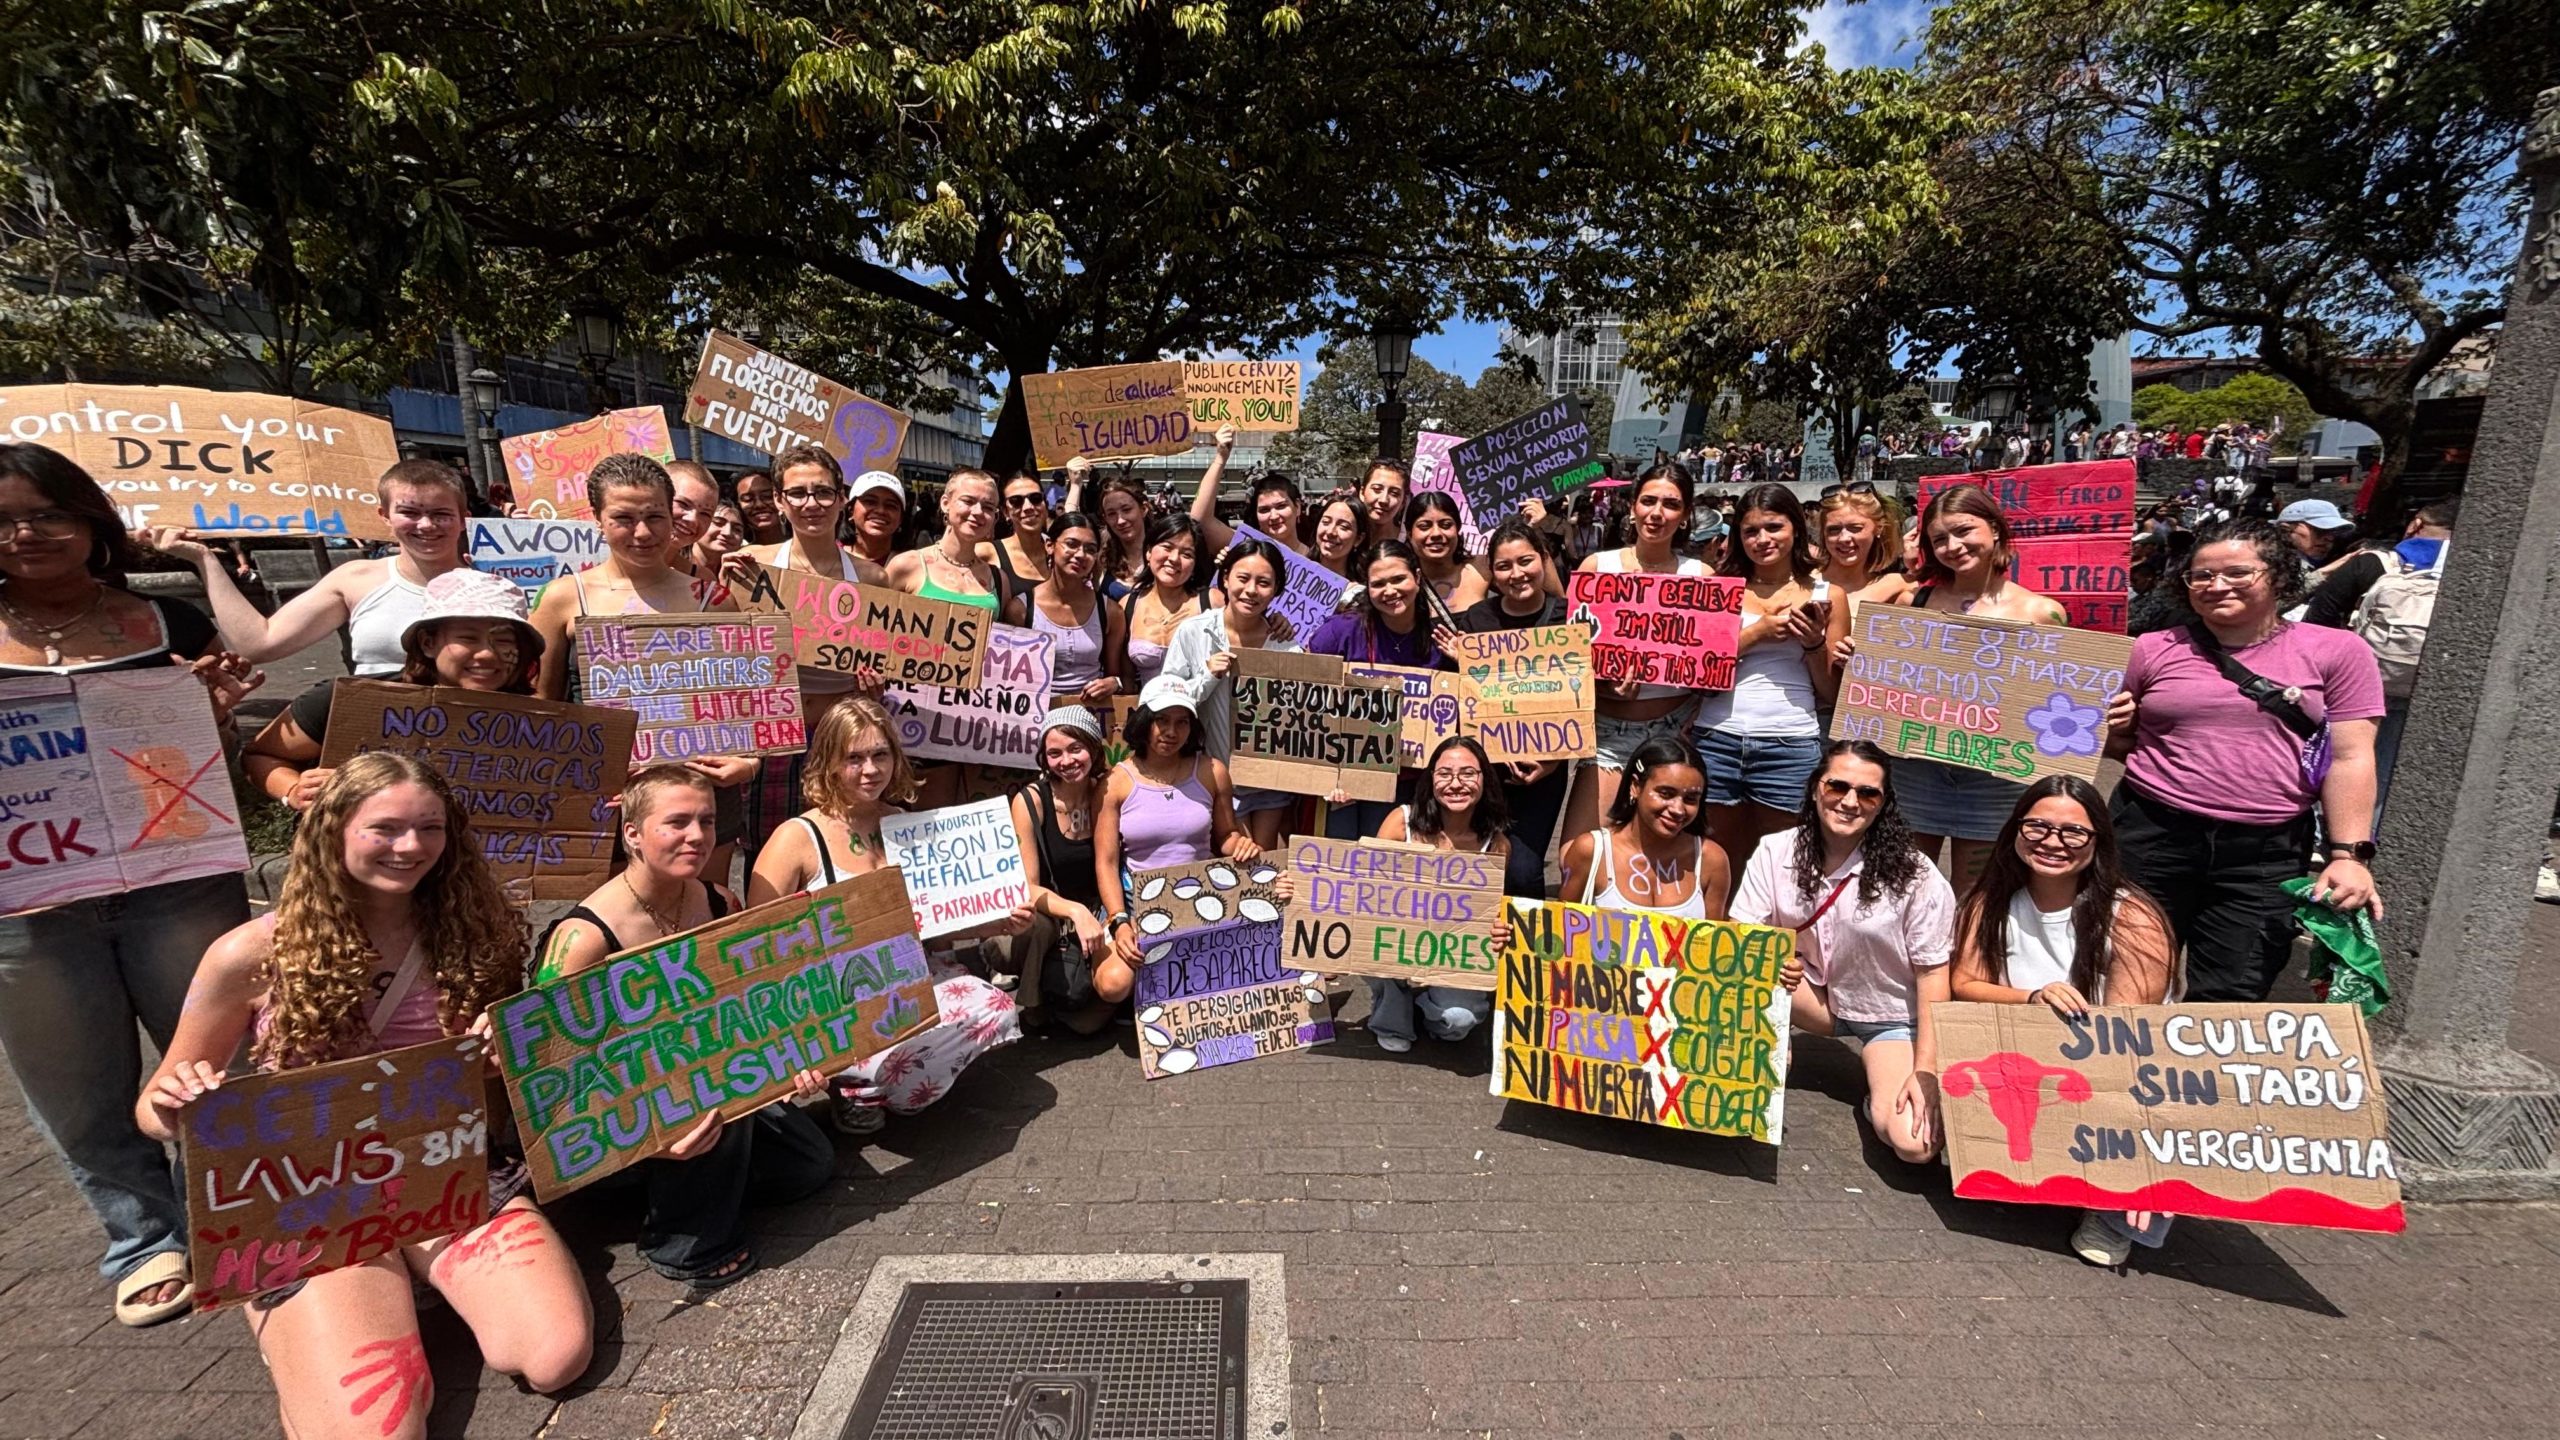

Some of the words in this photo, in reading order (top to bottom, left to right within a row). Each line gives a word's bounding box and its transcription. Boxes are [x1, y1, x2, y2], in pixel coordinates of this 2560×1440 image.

[709, 353, 829, 422] FLORECEMOS
[747, 350, 819, 394] JUNTAS
[1183, 362, 1236, 381] PUBLIC
[1239, 362, 1297, 378] CERVIX
[1184, 378, 1286, 395] NNOUNCEMENT
[221, 412, 344, 448] your
[1074, 410, 1190, 453] IGUALDAD
[1242, 398, 1293, 424] YOU!
[109, 436, 275, 475] DICK
[1458, 443, 1483, 466] MI
[1485, 402, 1569, 454] POSICION
[1465, 446, 1525, 487] SEXUAL
[1522, 420, 1590, 460] FAVORITA
[168, 476, 218, 496] try
[227, 478, 256, 493] to
[269, 481, 380, 505] contro
[1467, 487, 1493, 509] ES
[1495, 474, 1518, 497] YO
[1522, 447, 1578, 484] ARRIBA
[1578, 441, 1588, 458] Y
[2056, 485, 2122, 506] TIRED
[193, 502, 349, 536] World
[471, 523, 505, 556] A
[2037, 564, 2127, 593] TIRED
[751, 570, 786, 610] A
[944, 616, 978, 652] IS
[583, 623, 640, 665] WE
[643, 627, 715, 657] ARE
[716, 625, 778, 653] THE
[1461, 628, 1530, 660] SEAMOS
[1533, 627, 1570, 648] LAS
[1867, 613, 1967, 655] ESTE
[1972, 627, 2002, 669] 8
[2016, 628, 2064, 655] DE
[589, 656, 772, 699] DAUGHTERS
[1497, 651, 1586, 683] LOCAS
[1851, 652, 2005, 706] QUEREMOS
[692, 687, 797, 723] WITCHES
[899, 699, 918, 717] A
[938, 683, 1032, 716] ENSEÑO
[1231, 676, 1261, 705] LA
[1503, 699, 1520, 714] EL
[1847, 682, 2002, 734] DERECHOS
[383, 706, 448, 738] NO
[458, 711, 604, 757] SOMOS
[1234, 723, 1395, 765] FEMINISTA!
[1480, 718, 1584, 756] MUNDO
[1842, 712, 1884, 744] NO
[1897, 720, 2036, 778] FLORES
[451, 785, 559, 822] OMOS
[894, 825, 917, 844] MY
[924, 808, 996, 837] FAVOURITE
[899, 829, 988, 869] SEASON
[993, 823, 1015, 851] IS
[996, 853, 1021, 874] OF
[1295, 841, 1489, 889] QUEREMOS
[1628, 852, 1683, 897] 8M
[932, 880, 1026, 925] PATRIARCHY
[1309, 876, 1473, 923] DERECHOS
[1291, 919, 1352, 961] NO
[1372, 925, 1499, 972] FLORES
[1506, 901, 1553, 956] NI
[1562, 906, 1661, 968] PUTA
[1660, 921, 1690, 971] X
[500, 935, 715, 1075] FUCK
[718, 896, 854, 977] THE
[1504, 952, 1544, 1004] NI
[1549, 959, 1647, 1017] MADRE
[1644, 976, 1674, 1023] X
[1668, 974, 1778, 1038] COGER
[1164, 1006, 1182, 1028] TE
[1187, 989, 1263, 1024] PERSIGAN
[519, 940, 912, 1132] PATRIARCHAL
[1254, 1040, 1271, 1054] TE
[1502, 1000, 1544, 1048] NI
[1547, 1007, 1639, 1064] PRESA
[1641, 1023, 1673, 1068] X
[1669, 1026, 1782, 1087] COGER
[2059, 1011, 2154, 1061] SIN
[2163, 1010, 2343, 1060] CULPA
[192, 1075, 348, 1150] GET
[379, 1057, 473, 1123] UR
[1504, 1046, 1551, 1102] NI
[1553, 1052, 1659, 1124] MUERTA
[1656, 1071, 1689, 1127] X
[1683, 1078, 1773, 1138] COGER
[2129, 1062, 2219, 1106] SIN
[2221, 1054, 2365, 1112] TABÚ
[206, 1131, 405, 1212] LAWS
[421, 1120, 487, 1167] 8M
[2068, 1123, 2137, 1164] SIN
[2140, 1124, 2398, 1181] VERGÜENZA
[336, 1169, 481, 1267] Body
